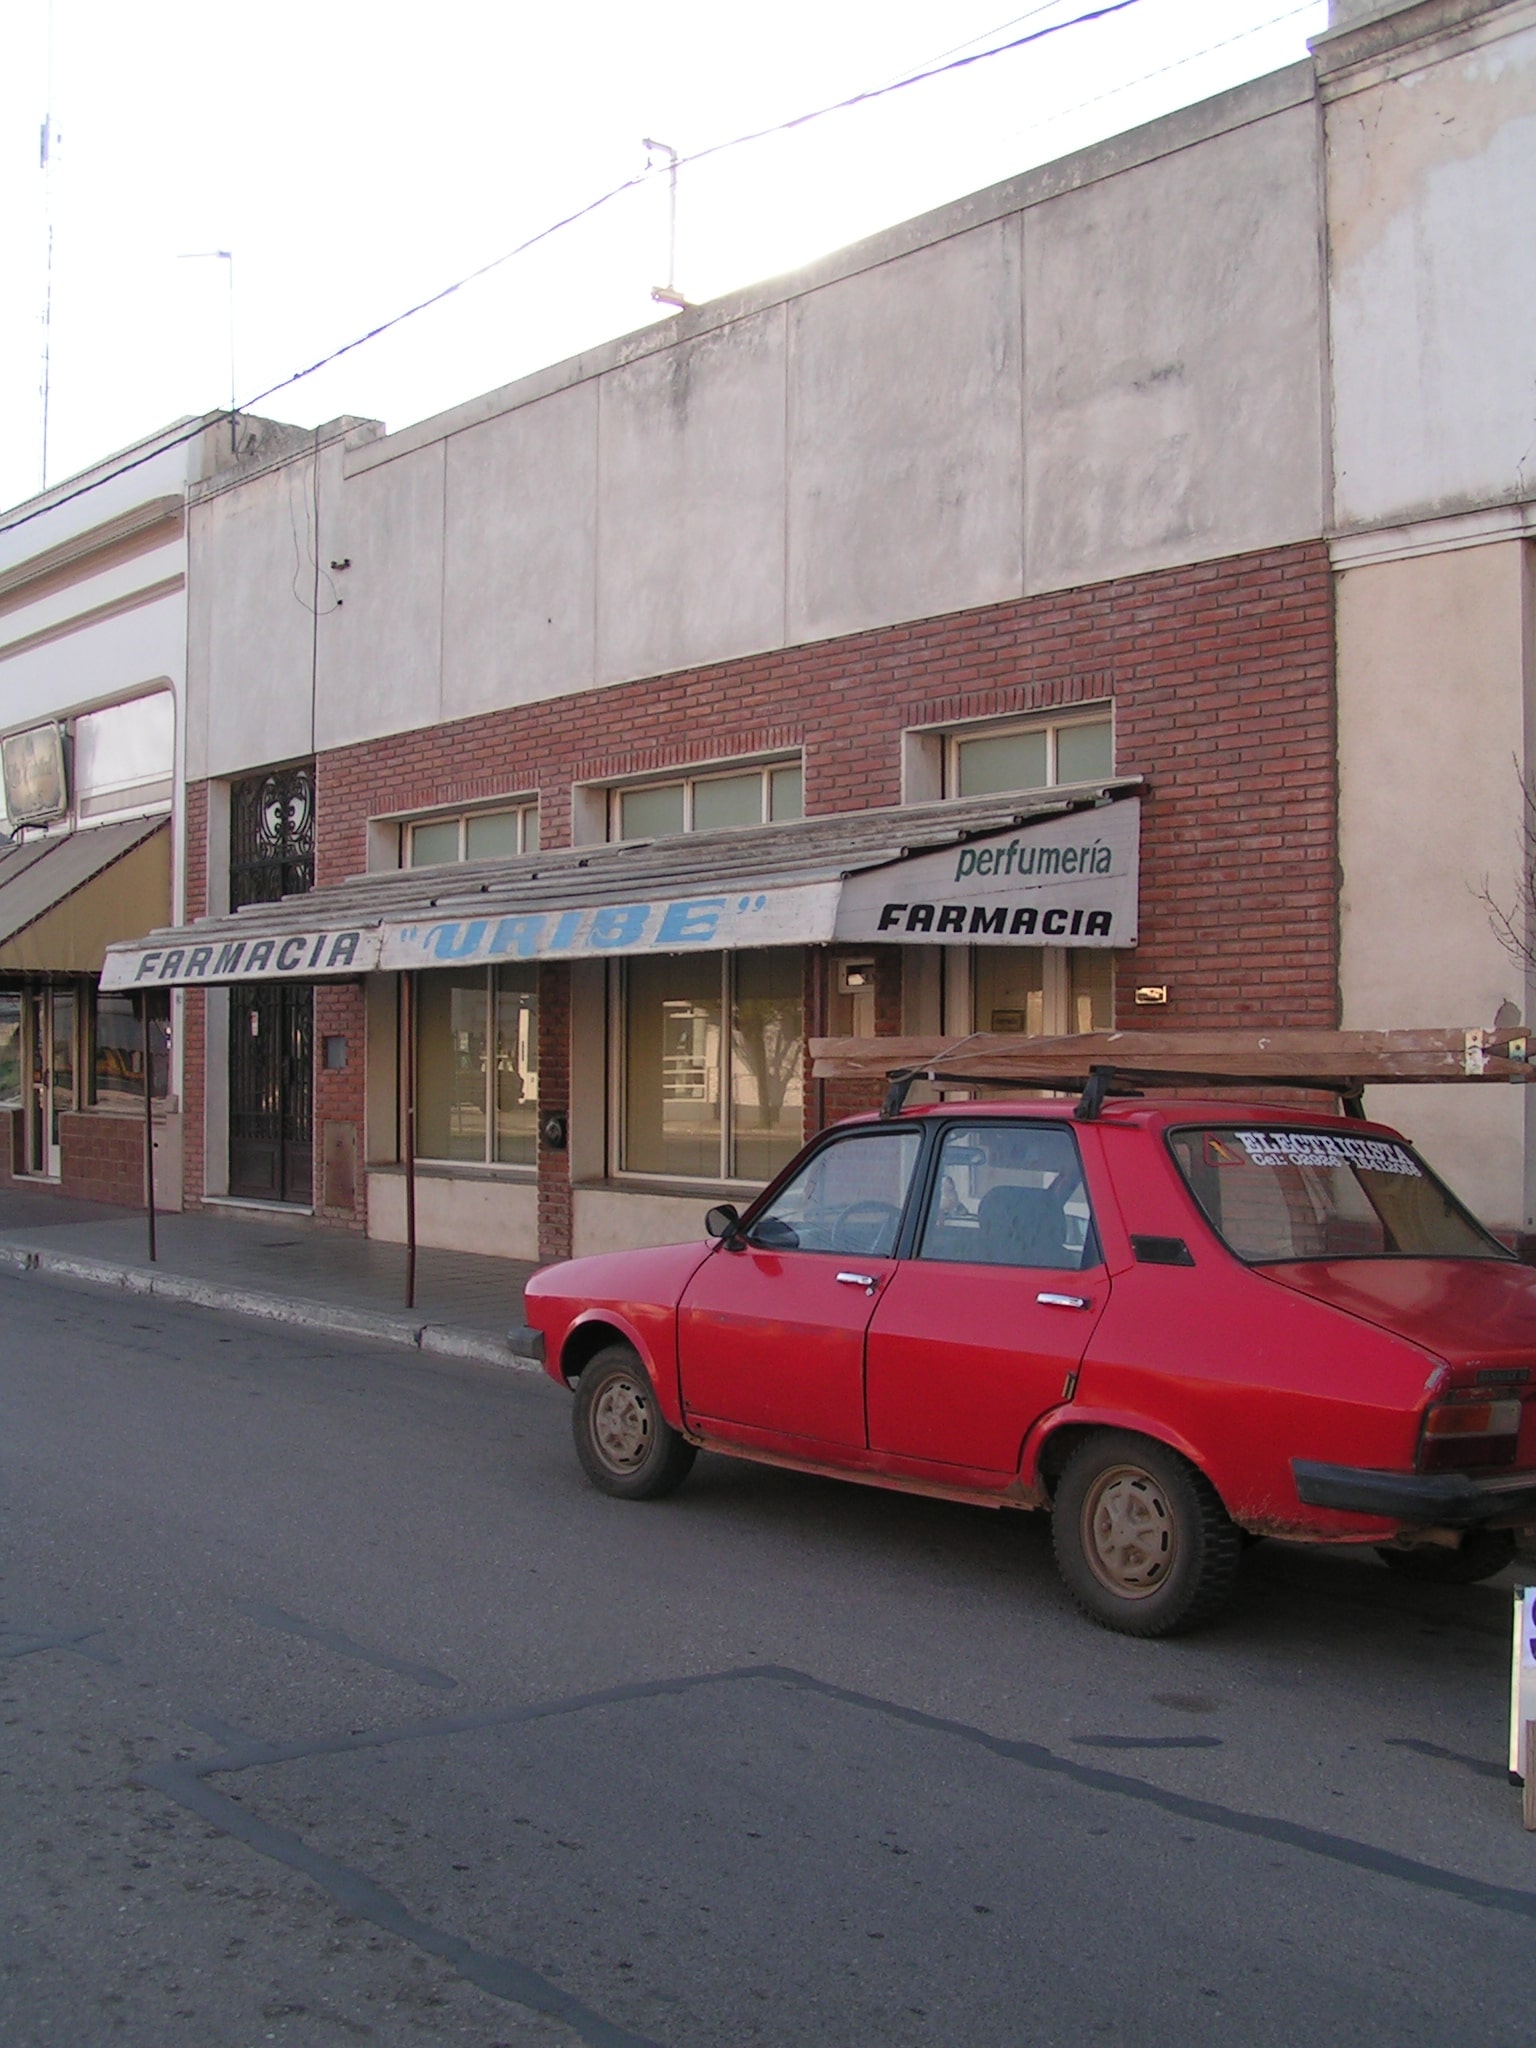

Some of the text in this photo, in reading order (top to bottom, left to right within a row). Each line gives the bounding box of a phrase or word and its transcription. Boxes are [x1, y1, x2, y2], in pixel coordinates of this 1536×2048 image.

[954, 839, 1112, 882] perfumería
[878, 903, 1112, 936] FARMACIA
[135, 932, 360, 981] FARMACIA
[1234, 1131, 1415, 1166] ELECTRICISTA
[1251, 1153, 1288, 1166] Cel:
